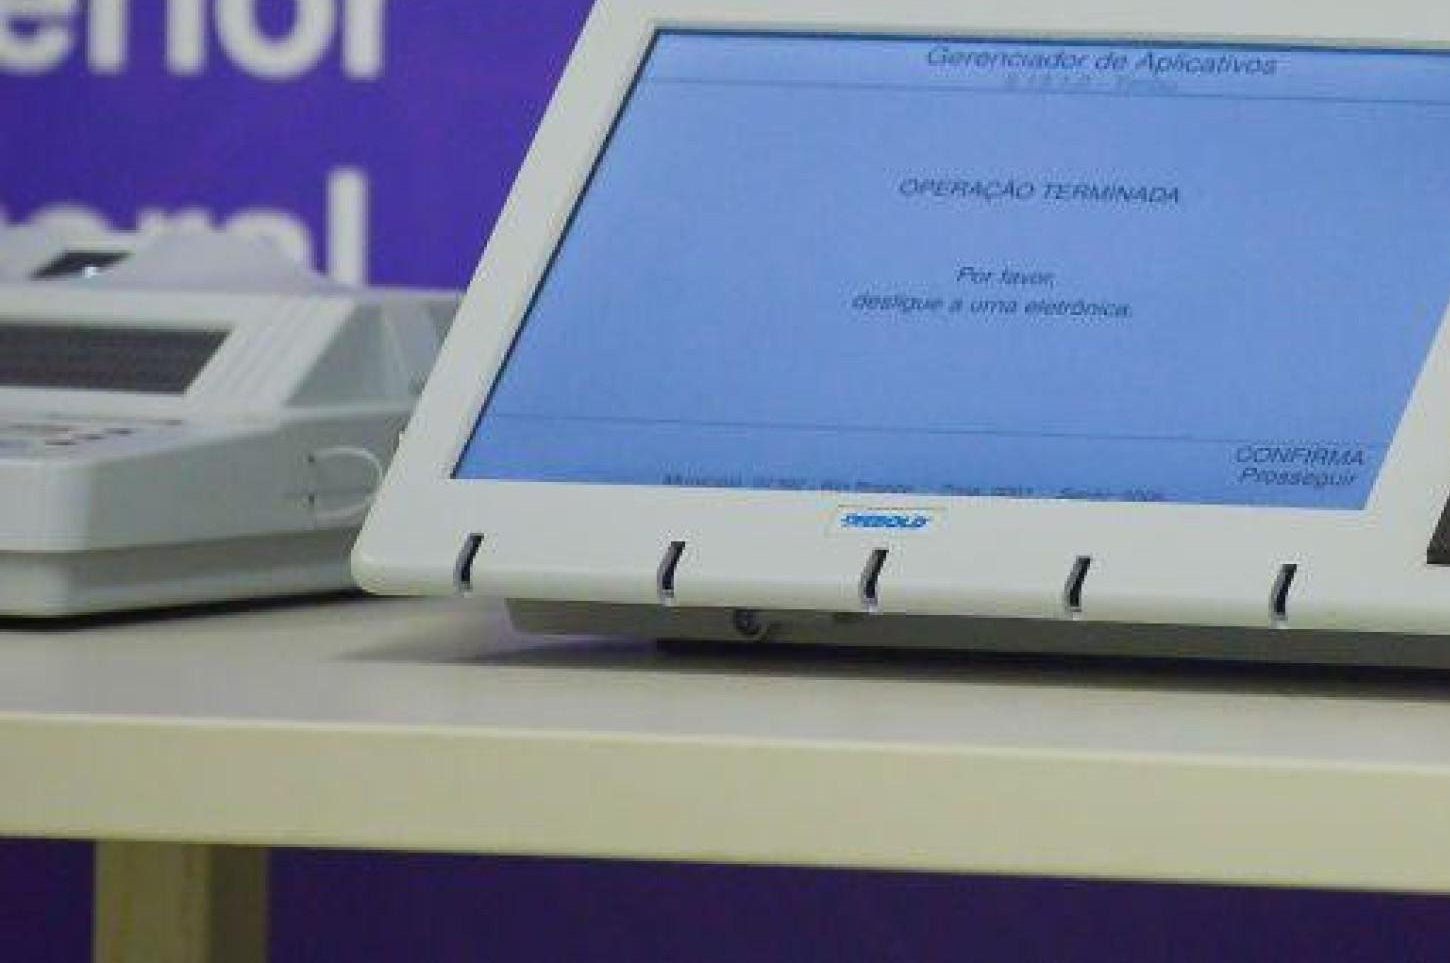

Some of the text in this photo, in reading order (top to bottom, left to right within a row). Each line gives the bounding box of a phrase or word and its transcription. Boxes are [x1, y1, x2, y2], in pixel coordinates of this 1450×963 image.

[926, 44, 1277, 78] Gerenciador de Aplicativos
[898, 173, 1181, 204] OPERAÇÃO TERMINADA
[956, 266, 992, 284] Por
[1236, 446, 1366, 466] CONFIRMA
[1238, 467, 1357, 490] Prosseguir
